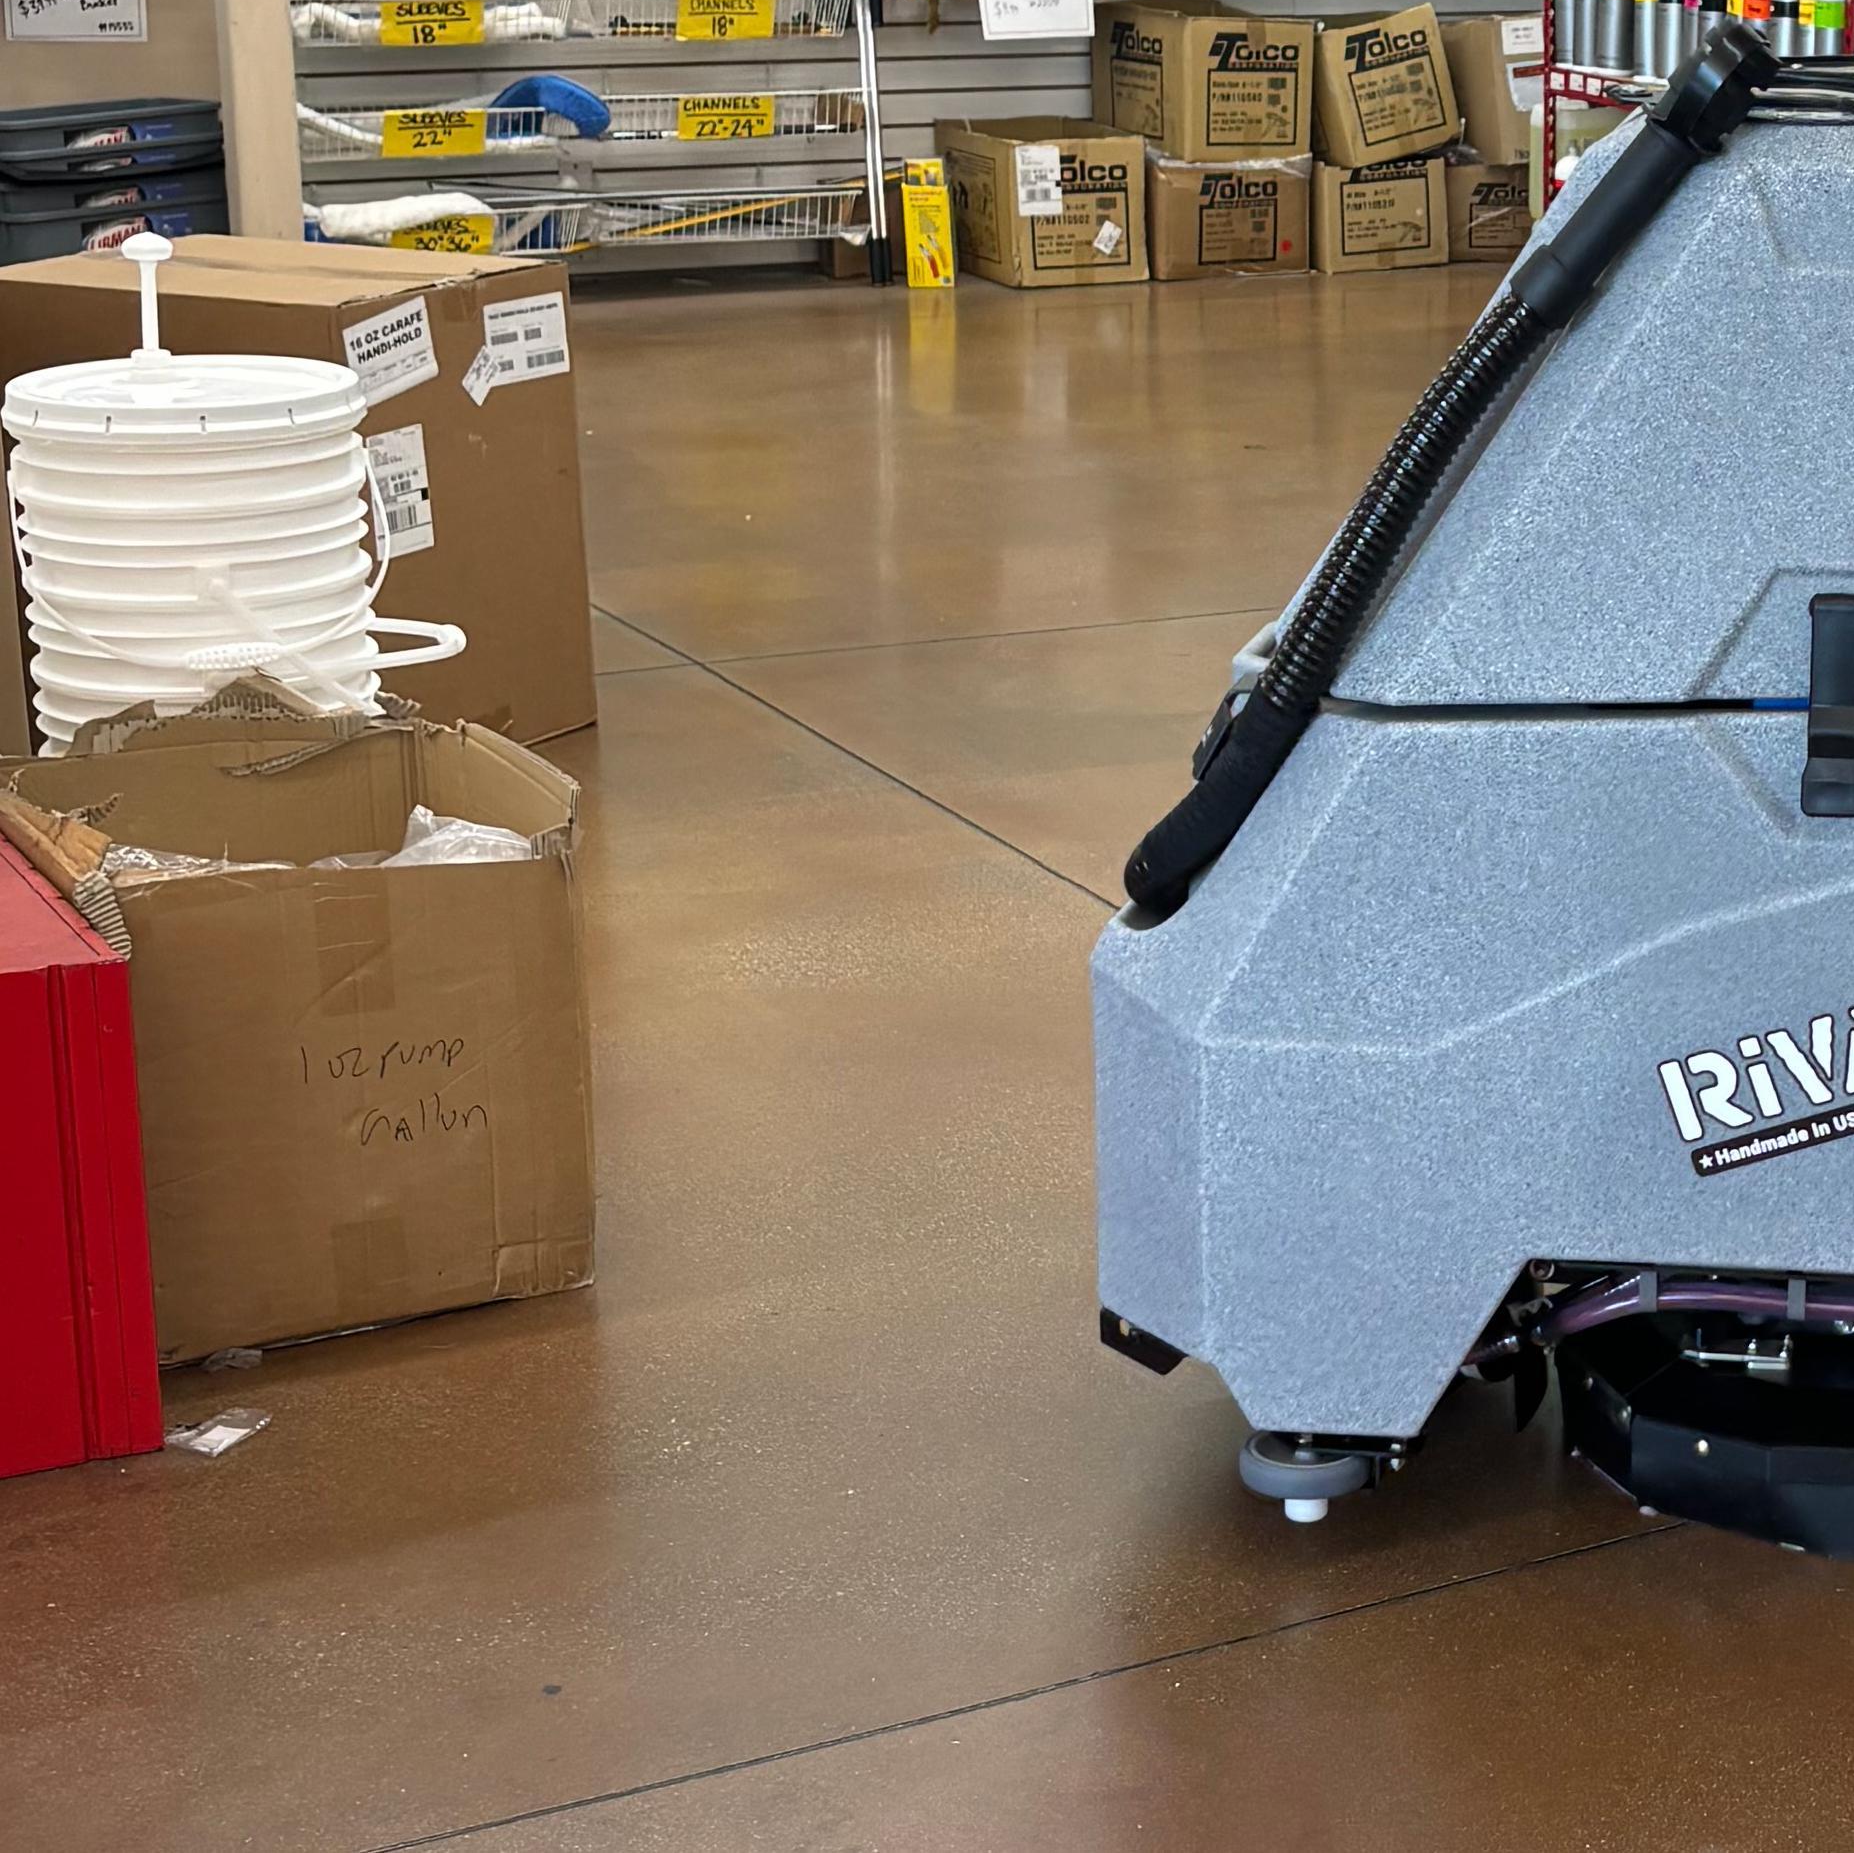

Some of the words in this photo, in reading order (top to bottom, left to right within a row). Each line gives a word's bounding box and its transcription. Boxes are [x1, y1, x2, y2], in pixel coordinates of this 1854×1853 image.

[396, 1, 466, 16] SLEEVES
[1110, 21, 1163, 58] Tolco
[1344, 27, 1428, 72] Tolco
[399, 111, 468, 125] SLEEVES
[683, 96, 761, 111] CHANNELS
[1060, 155, 1127, 182] olco
[1200, 173, 1278, 208] Tolco
[350, 339, 363, 352] 16
[365, 330, 379, 345] OZ
[382, 309, 423, 337] CARAFE
[357, 327, 423, 364] HANDI-HOLD
[1715, 1127, 1809, 1166] Handmade
